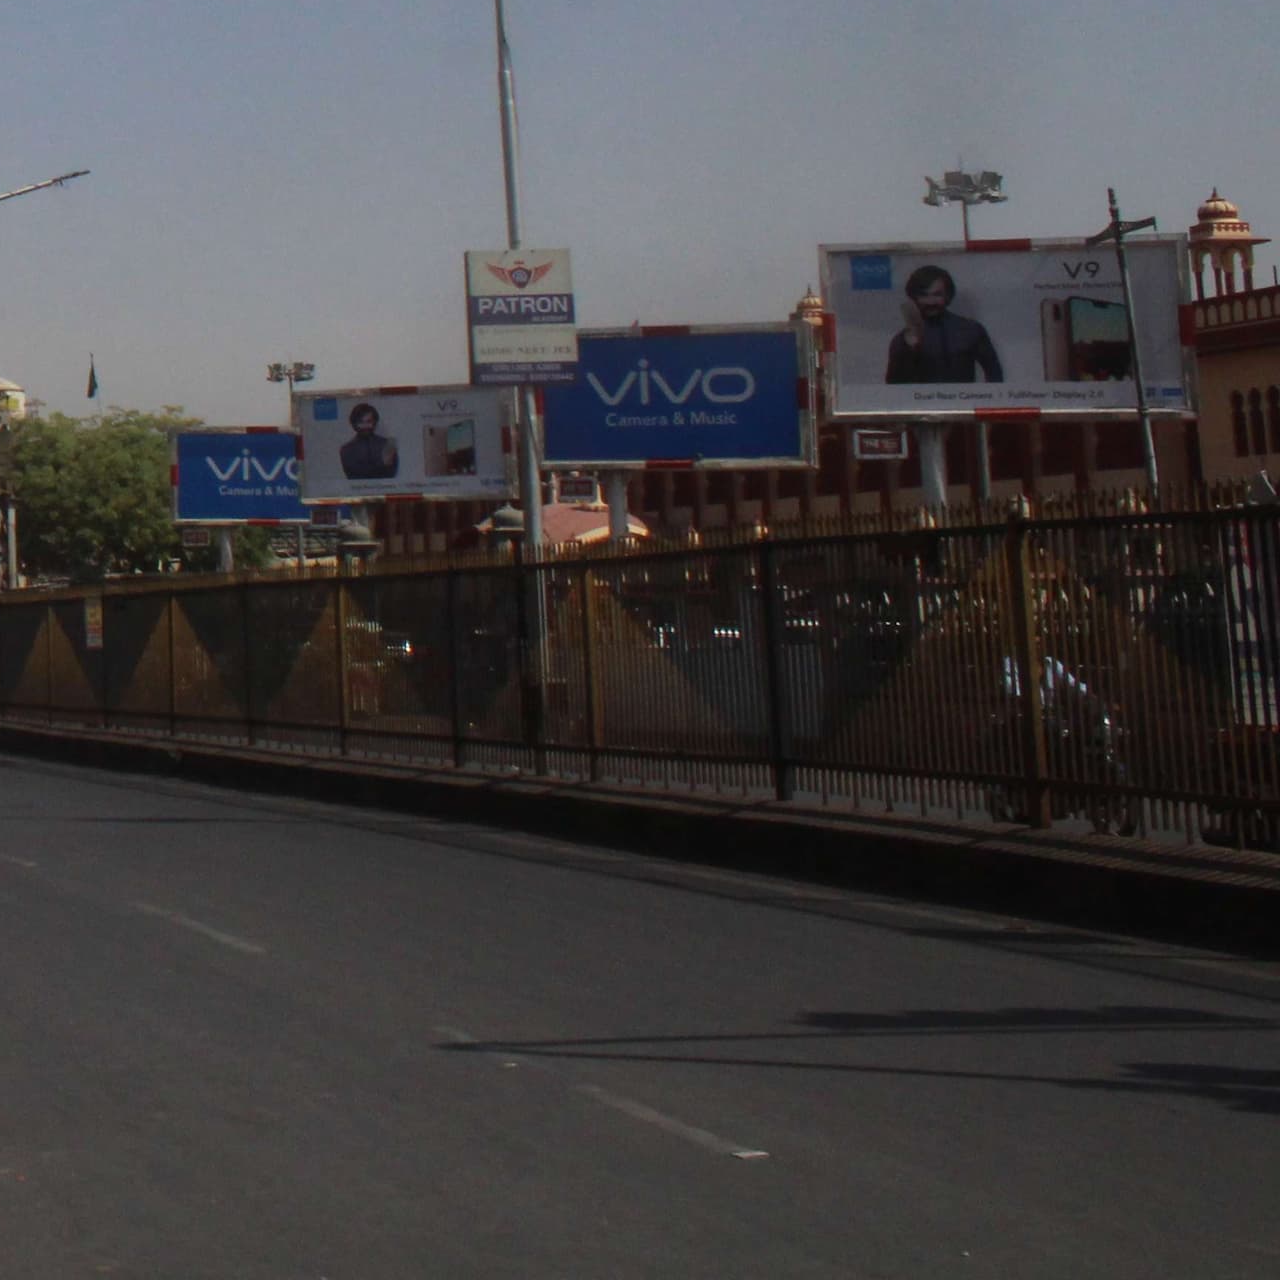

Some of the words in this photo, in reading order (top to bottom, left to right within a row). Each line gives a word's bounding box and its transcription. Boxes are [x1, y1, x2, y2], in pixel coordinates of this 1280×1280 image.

[1063, 262, 1101, 279] V9
[478, 297, 568, 314] PATRON
[585, 358, 755, 406] vivo
[605, 412, 668, 427] Camera
[673, 411, 685, 425] &
[690, 410, 737, 425] Music
[218, 485, 261, 497] Camera
